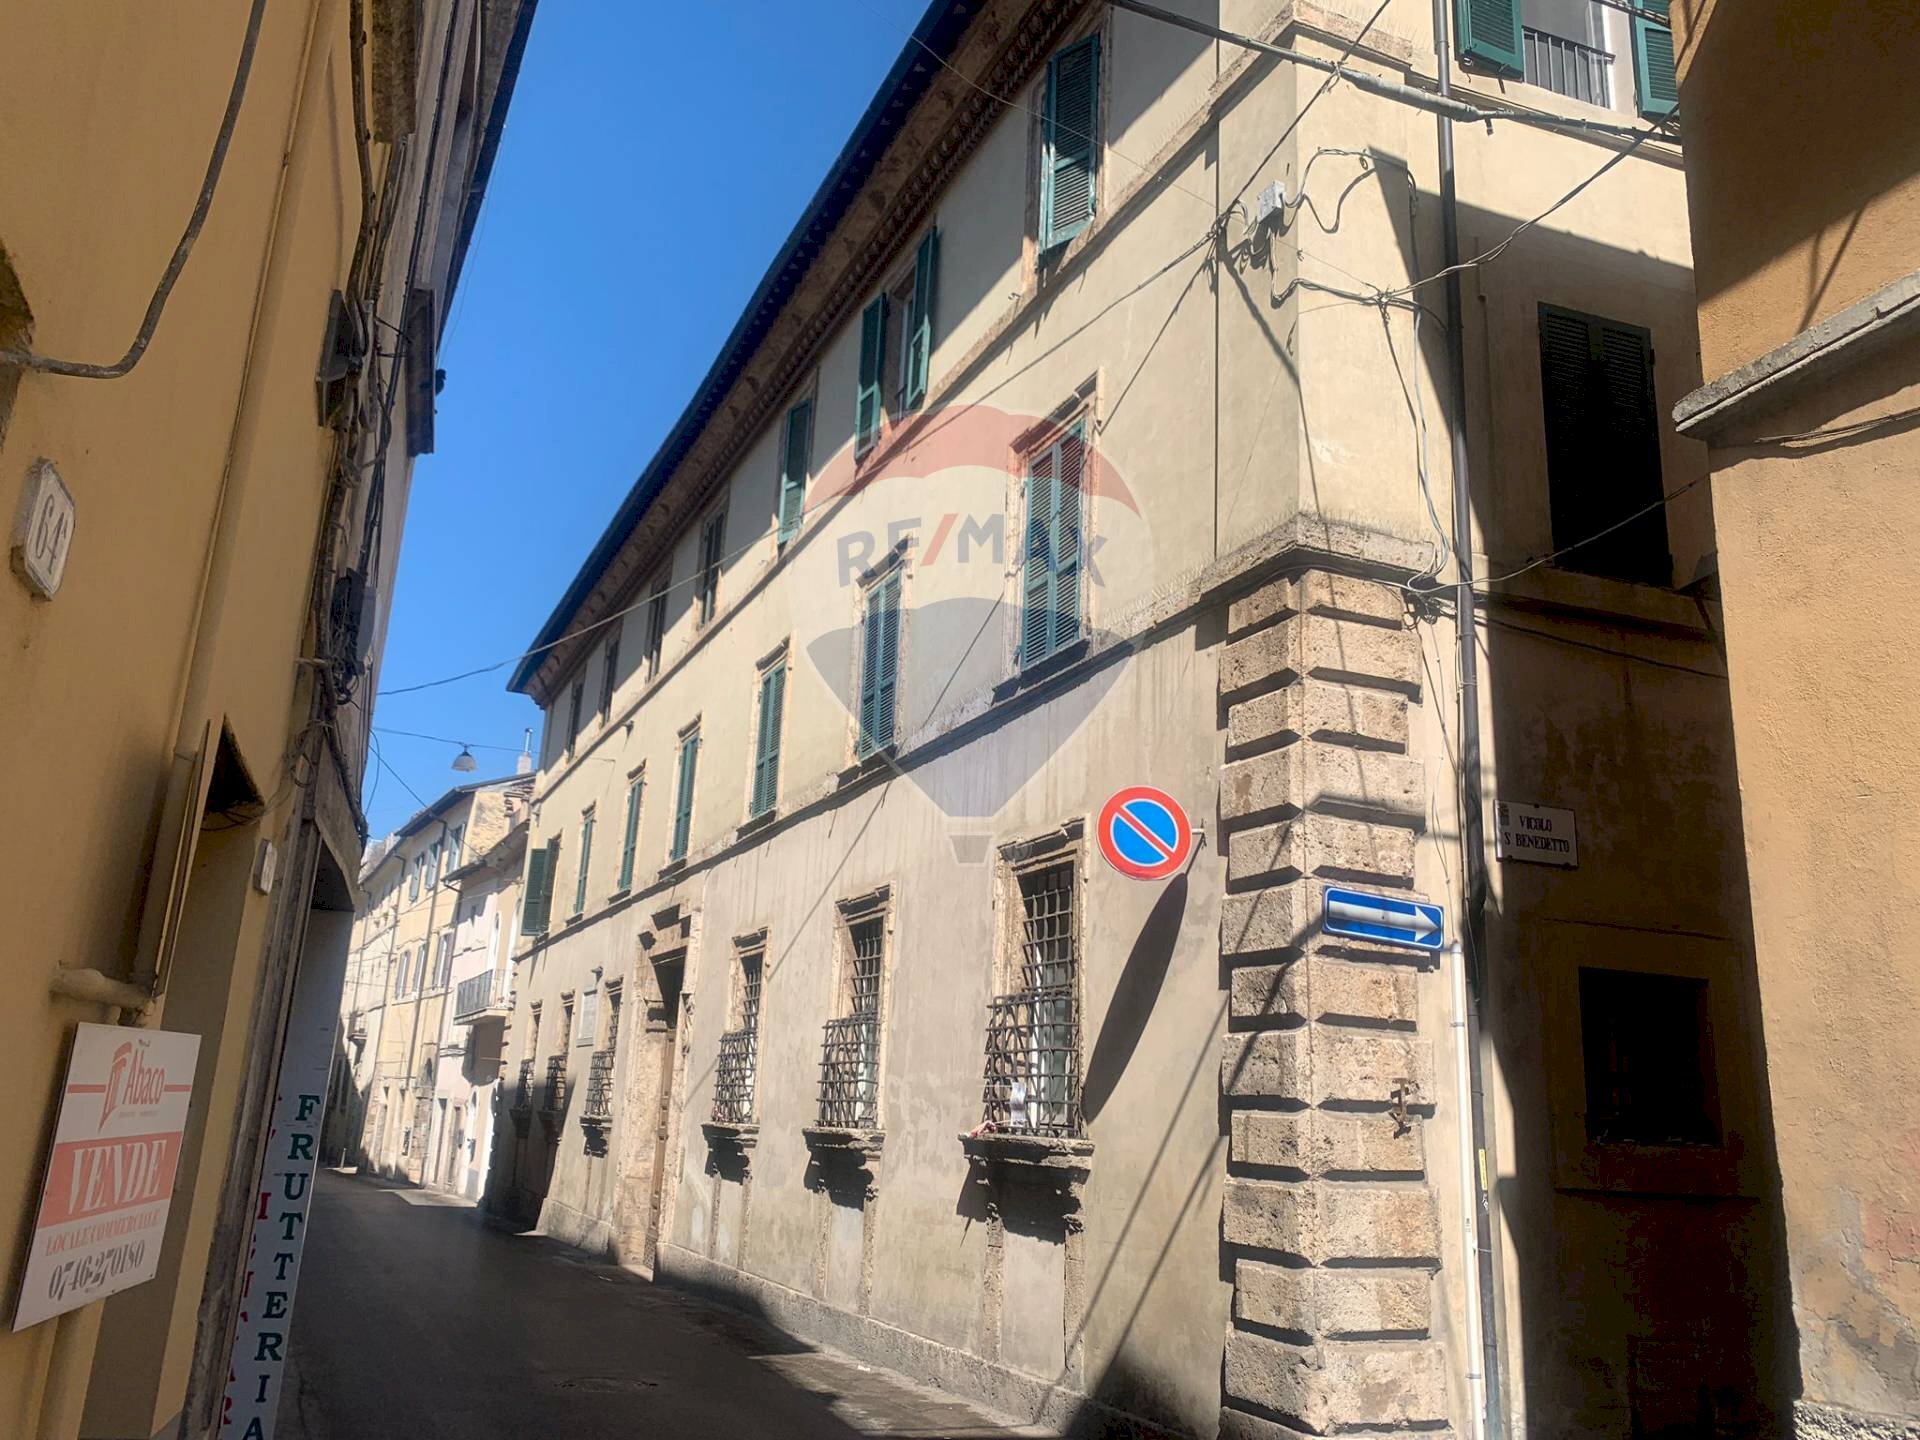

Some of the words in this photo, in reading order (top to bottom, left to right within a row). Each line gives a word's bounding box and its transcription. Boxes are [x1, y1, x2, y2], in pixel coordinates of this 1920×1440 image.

[1504, 832, 1511, 845] S
[1516, 833, 1569, 853] BENEDETTO
[1519, 816, 1552, 832] VICOLO
[122, 1048, 165, 1105] Abaco
[67, 1140, 167, 1216] VENDE
[242, 1094, 320, 1440] FRUTTERIA
